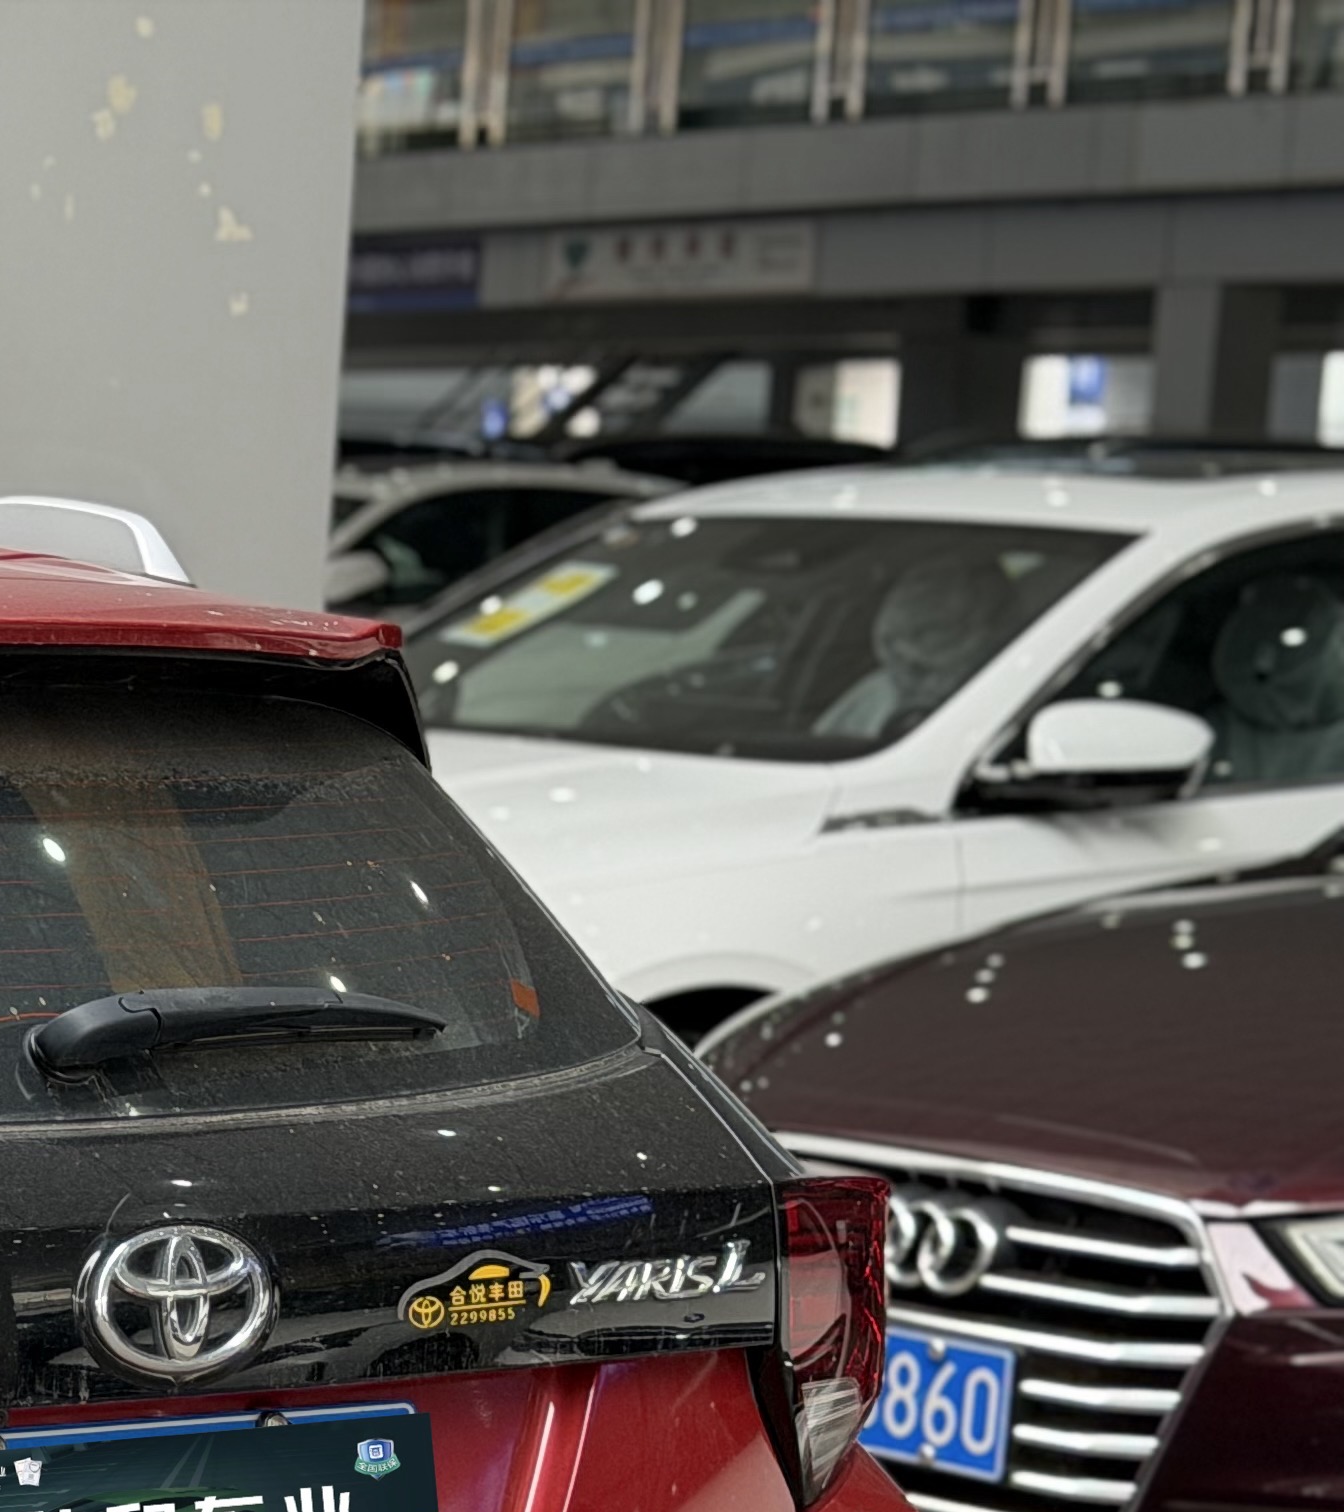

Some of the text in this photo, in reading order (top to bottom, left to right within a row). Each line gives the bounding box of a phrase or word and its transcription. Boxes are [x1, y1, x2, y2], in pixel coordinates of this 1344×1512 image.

[449, 1280, 524, 1305] 合悦丰田
[449, 1307, 516, 1327] 2299855
[862, 1351, 1000, 1456] 860
